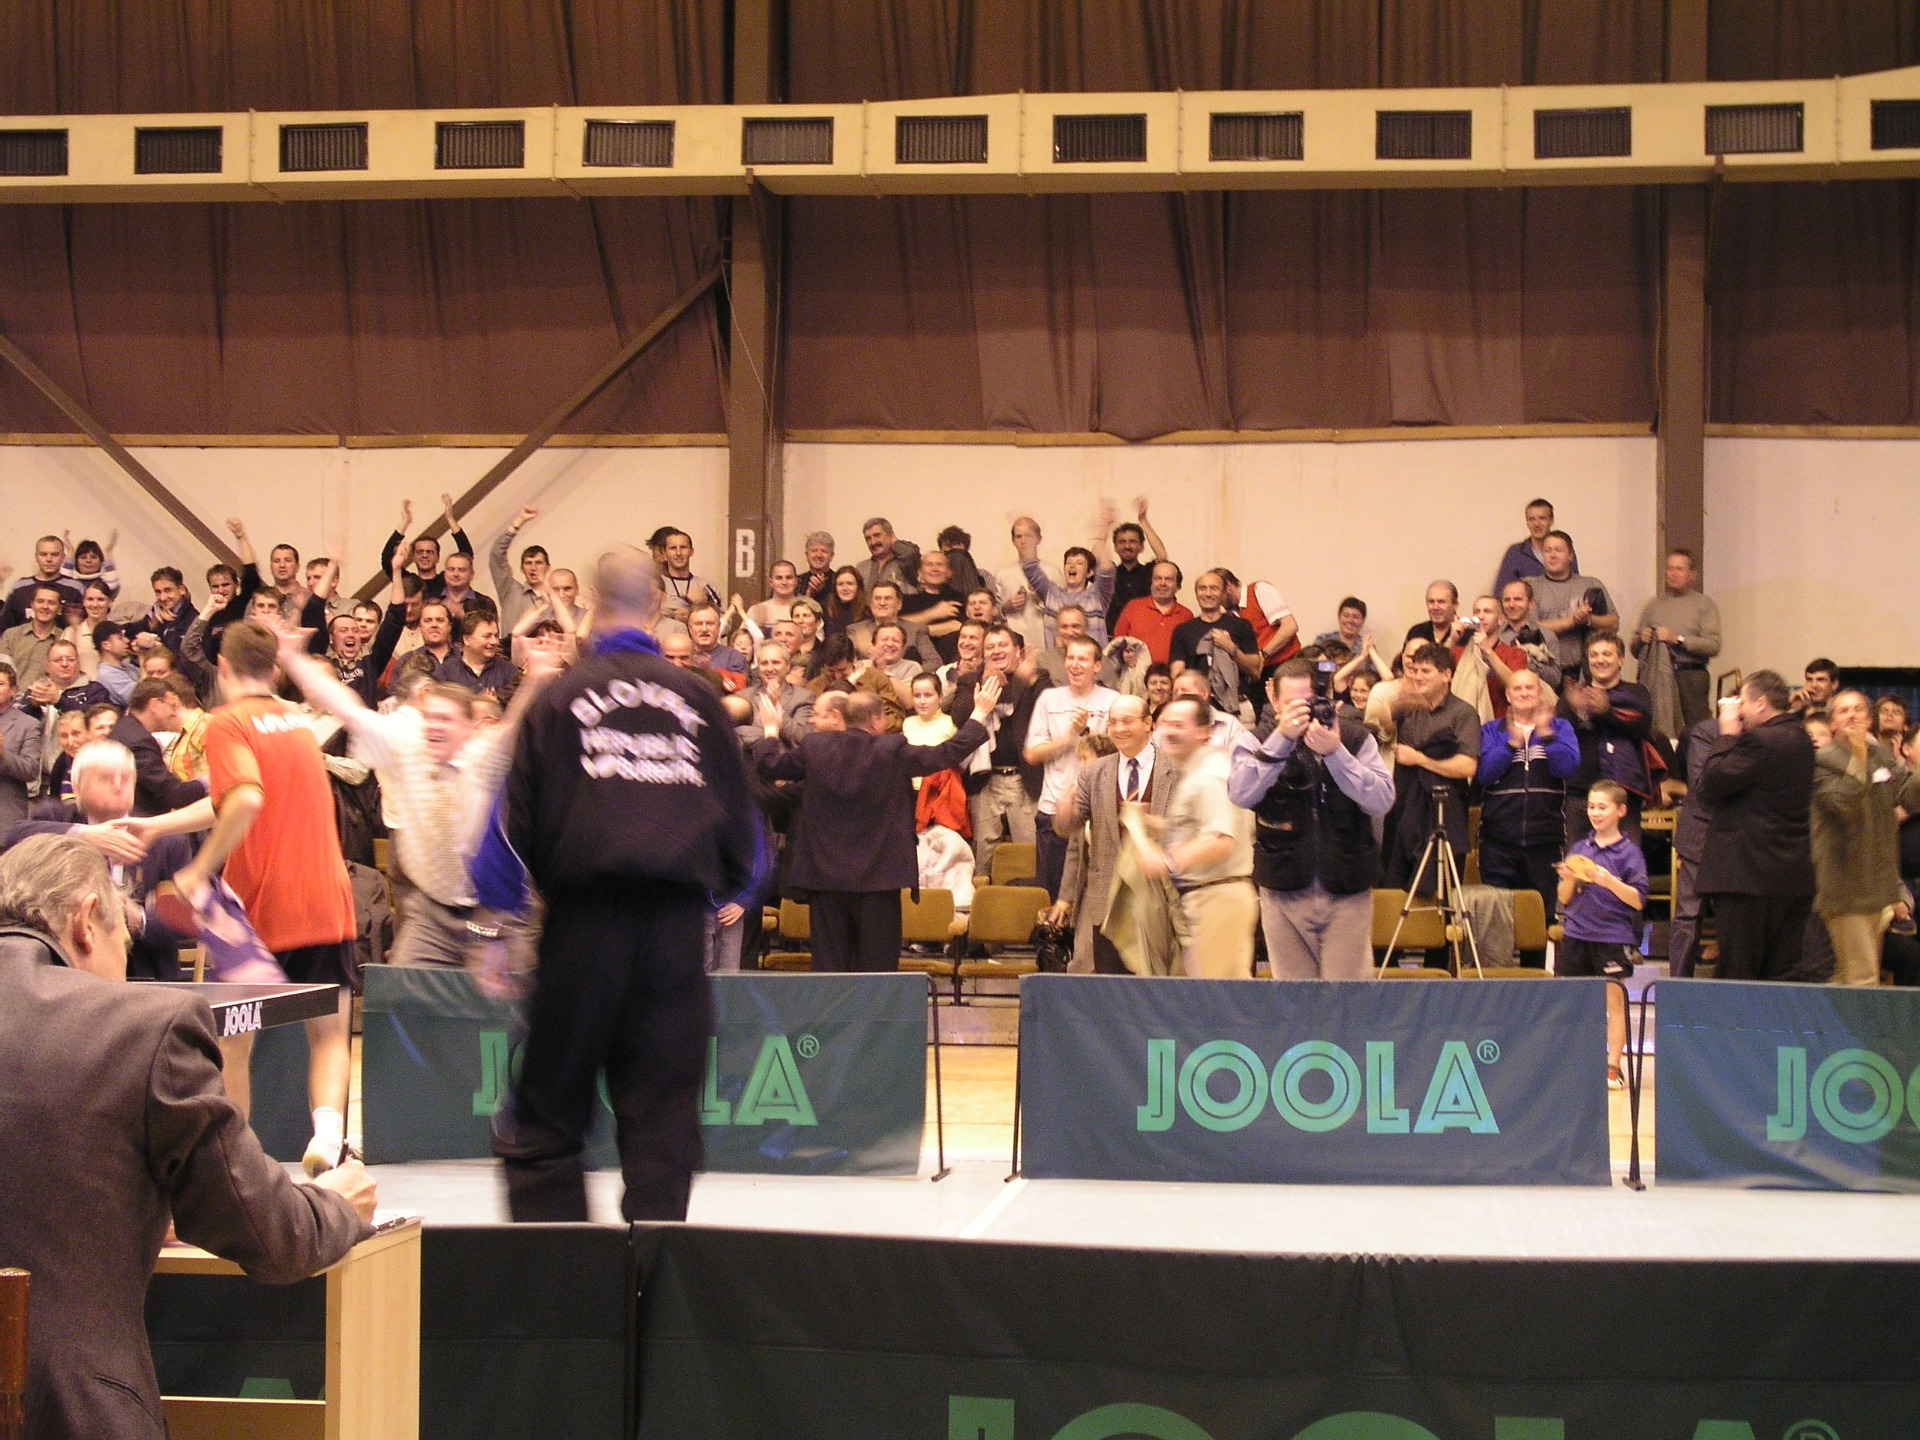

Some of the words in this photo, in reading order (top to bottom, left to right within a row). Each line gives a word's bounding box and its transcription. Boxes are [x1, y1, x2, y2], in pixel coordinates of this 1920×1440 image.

[736, 529, 755, 577] B
[224, 1001, 262, 1037] JOOLA
[472, 1031, 818, 1126] JLA
[1137, 1039, 1500, 1134] JOOLA
[1766, 1046, 1920, 1143] JO
